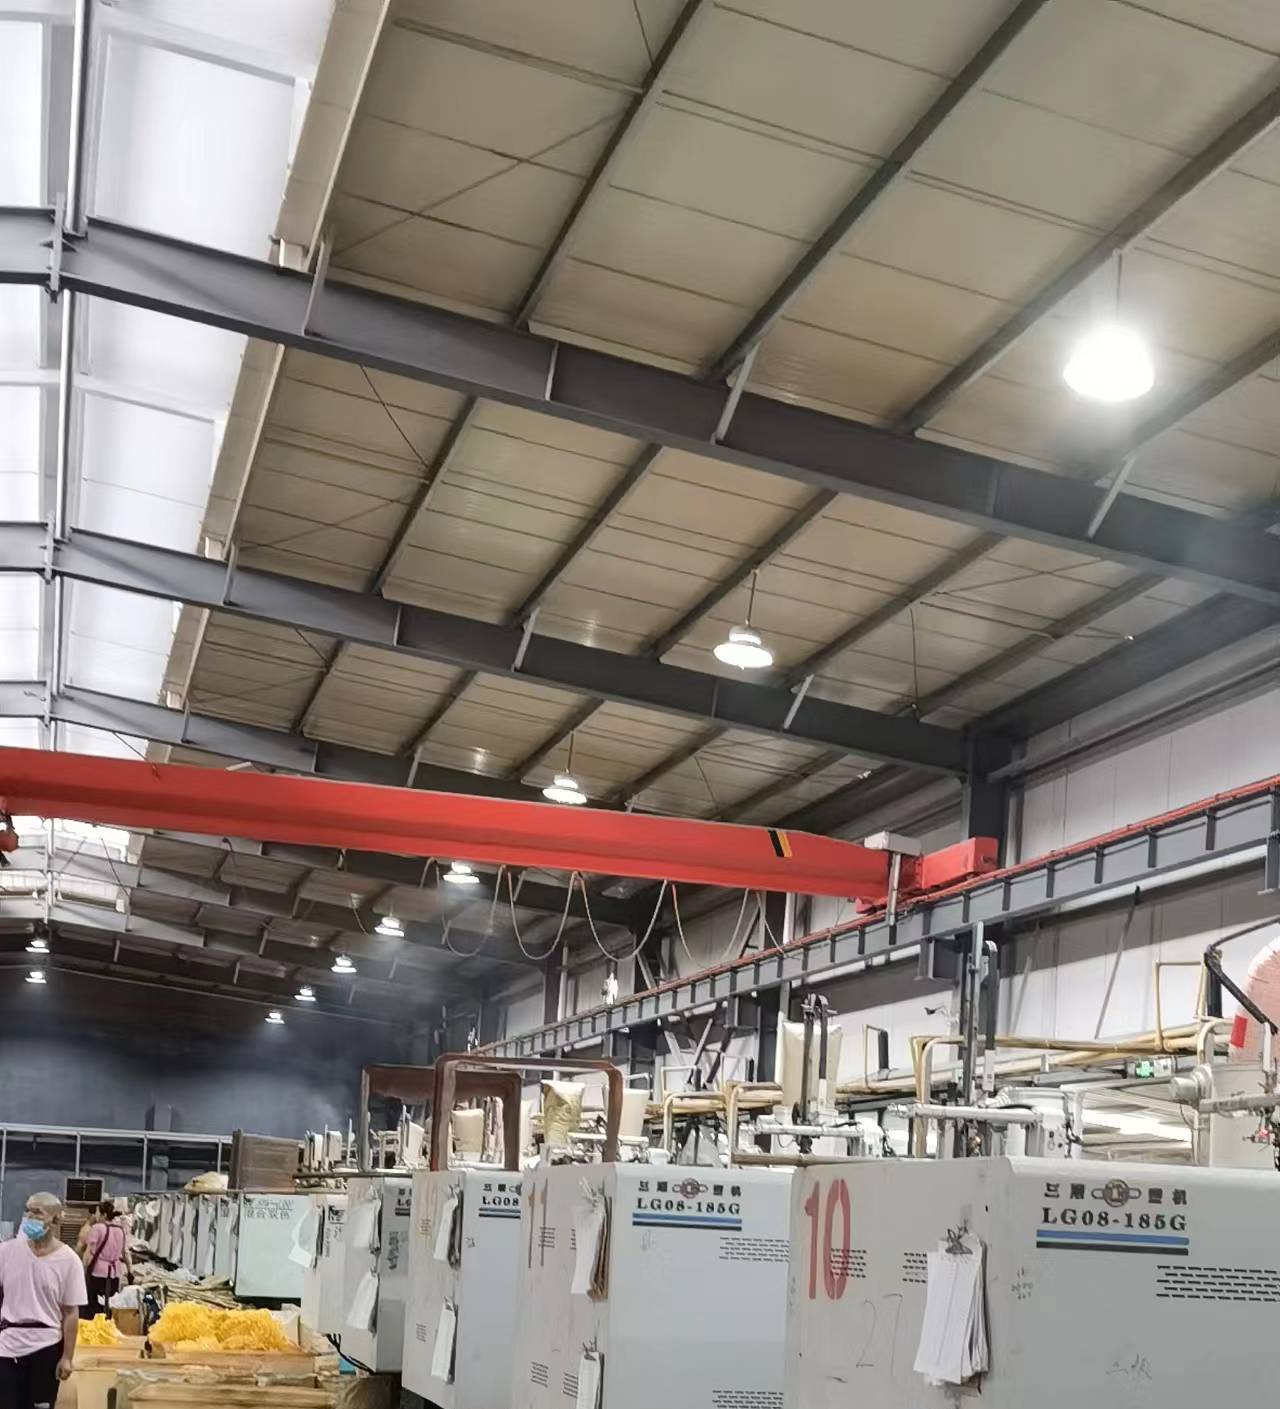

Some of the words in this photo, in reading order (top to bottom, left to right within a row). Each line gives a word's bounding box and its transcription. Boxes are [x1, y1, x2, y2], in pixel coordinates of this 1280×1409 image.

[636, 1197, 741, 1215] LG08-185G
[1041, 1207, 1187, 1231] LG08-185G
[804, 1177, 852, 1301] 10
